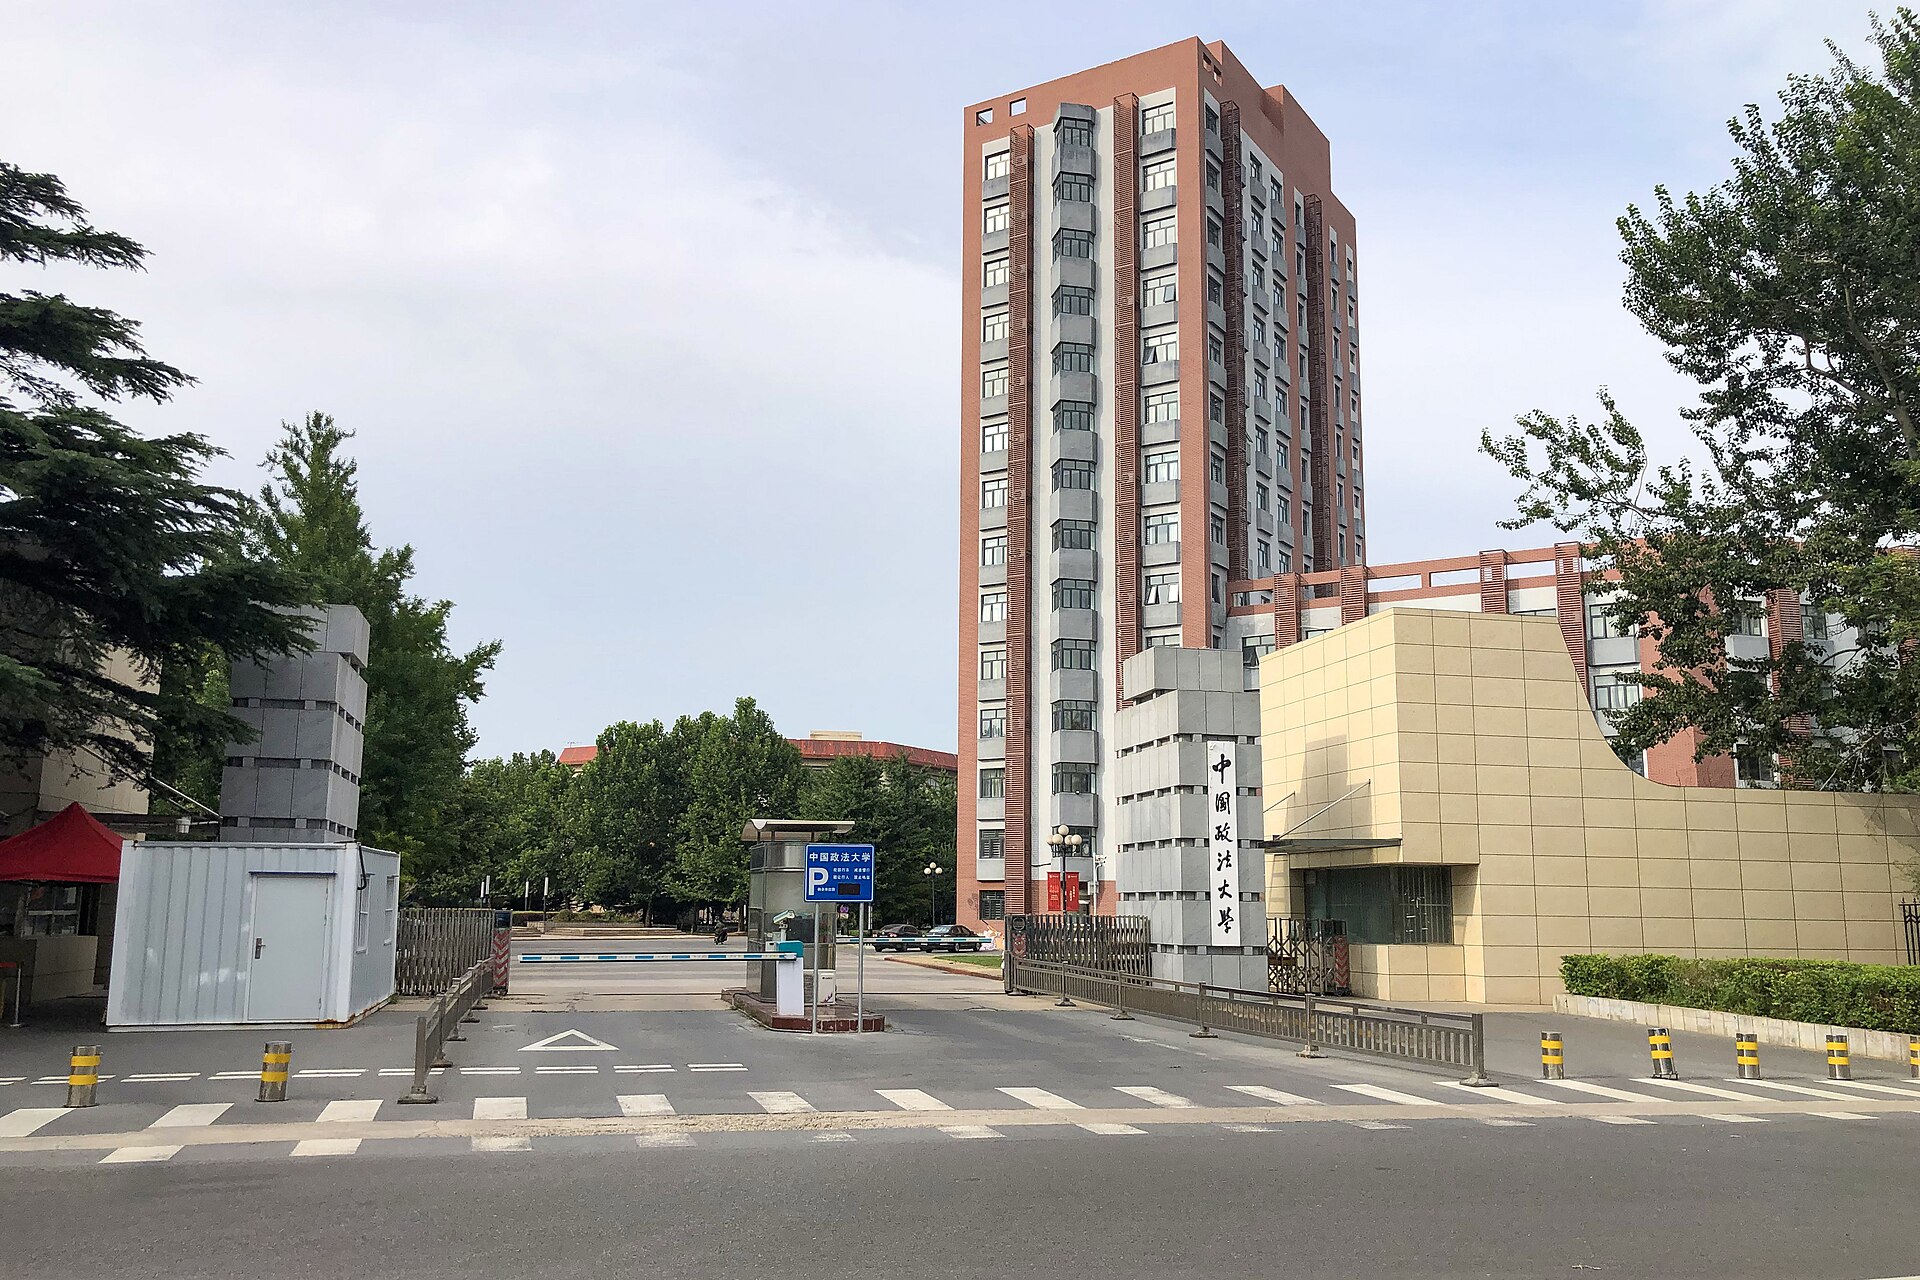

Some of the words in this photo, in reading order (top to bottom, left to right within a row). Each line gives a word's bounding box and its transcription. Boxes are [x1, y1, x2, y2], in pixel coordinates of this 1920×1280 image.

[809, 852, 871, 862] 中国政法大学
[809, 868, 829, 896] P
